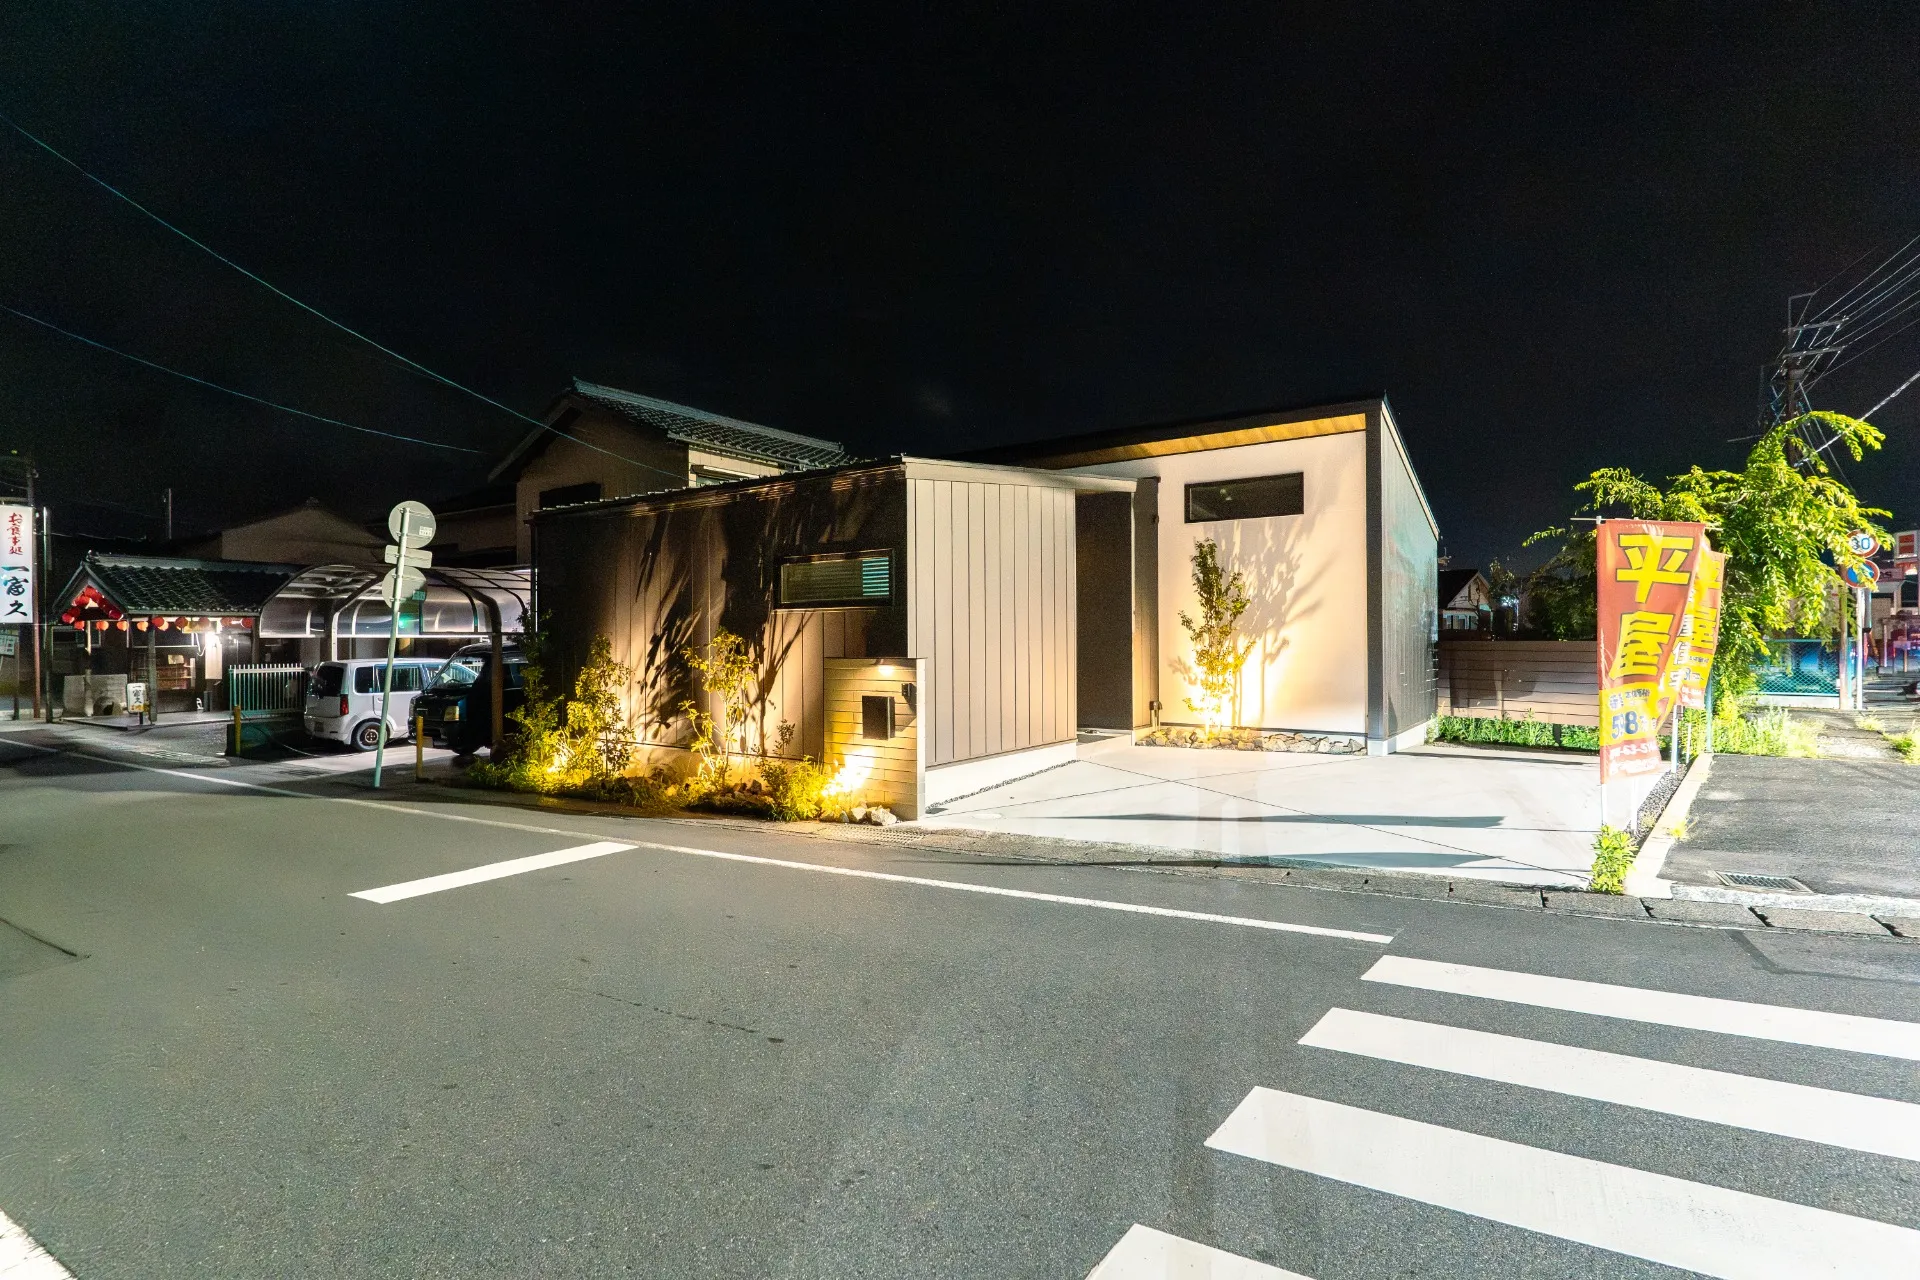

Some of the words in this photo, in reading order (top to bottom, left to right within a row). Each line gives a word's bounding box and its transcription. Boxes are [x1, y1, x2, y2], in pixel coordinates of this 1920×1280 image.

[7, 512, 23, 555] お食事処
[1851, 537, 1870, 550] 30
[1609, 533, 1694, 679] 平屋
